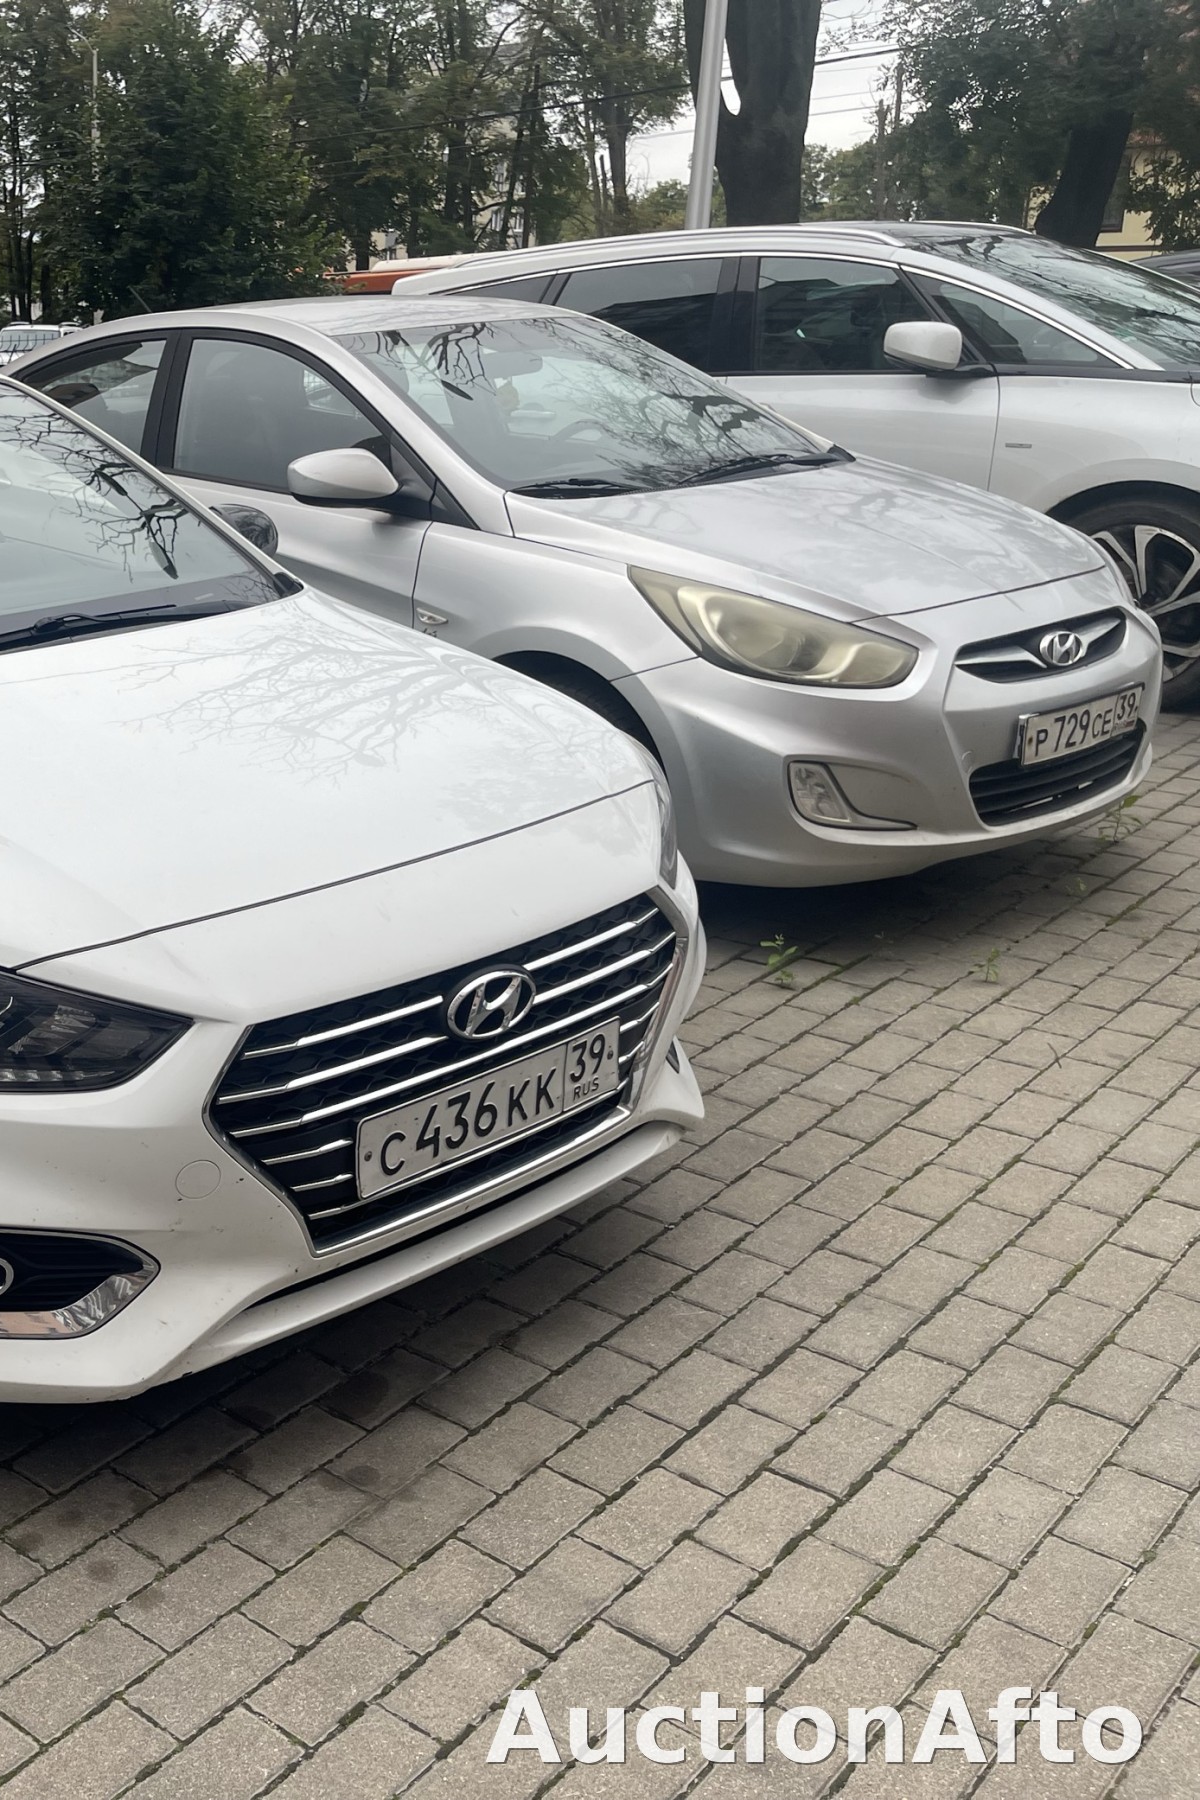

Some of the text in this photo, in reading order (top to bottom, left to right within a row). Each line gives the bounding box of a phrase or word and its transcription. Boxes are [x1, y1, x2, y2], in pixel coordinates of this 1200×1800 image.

[1117, 692, 1136, 721] 39
[569, 1033, 606, 1083] 39
[572, 1077, 600, 1101] RUS
